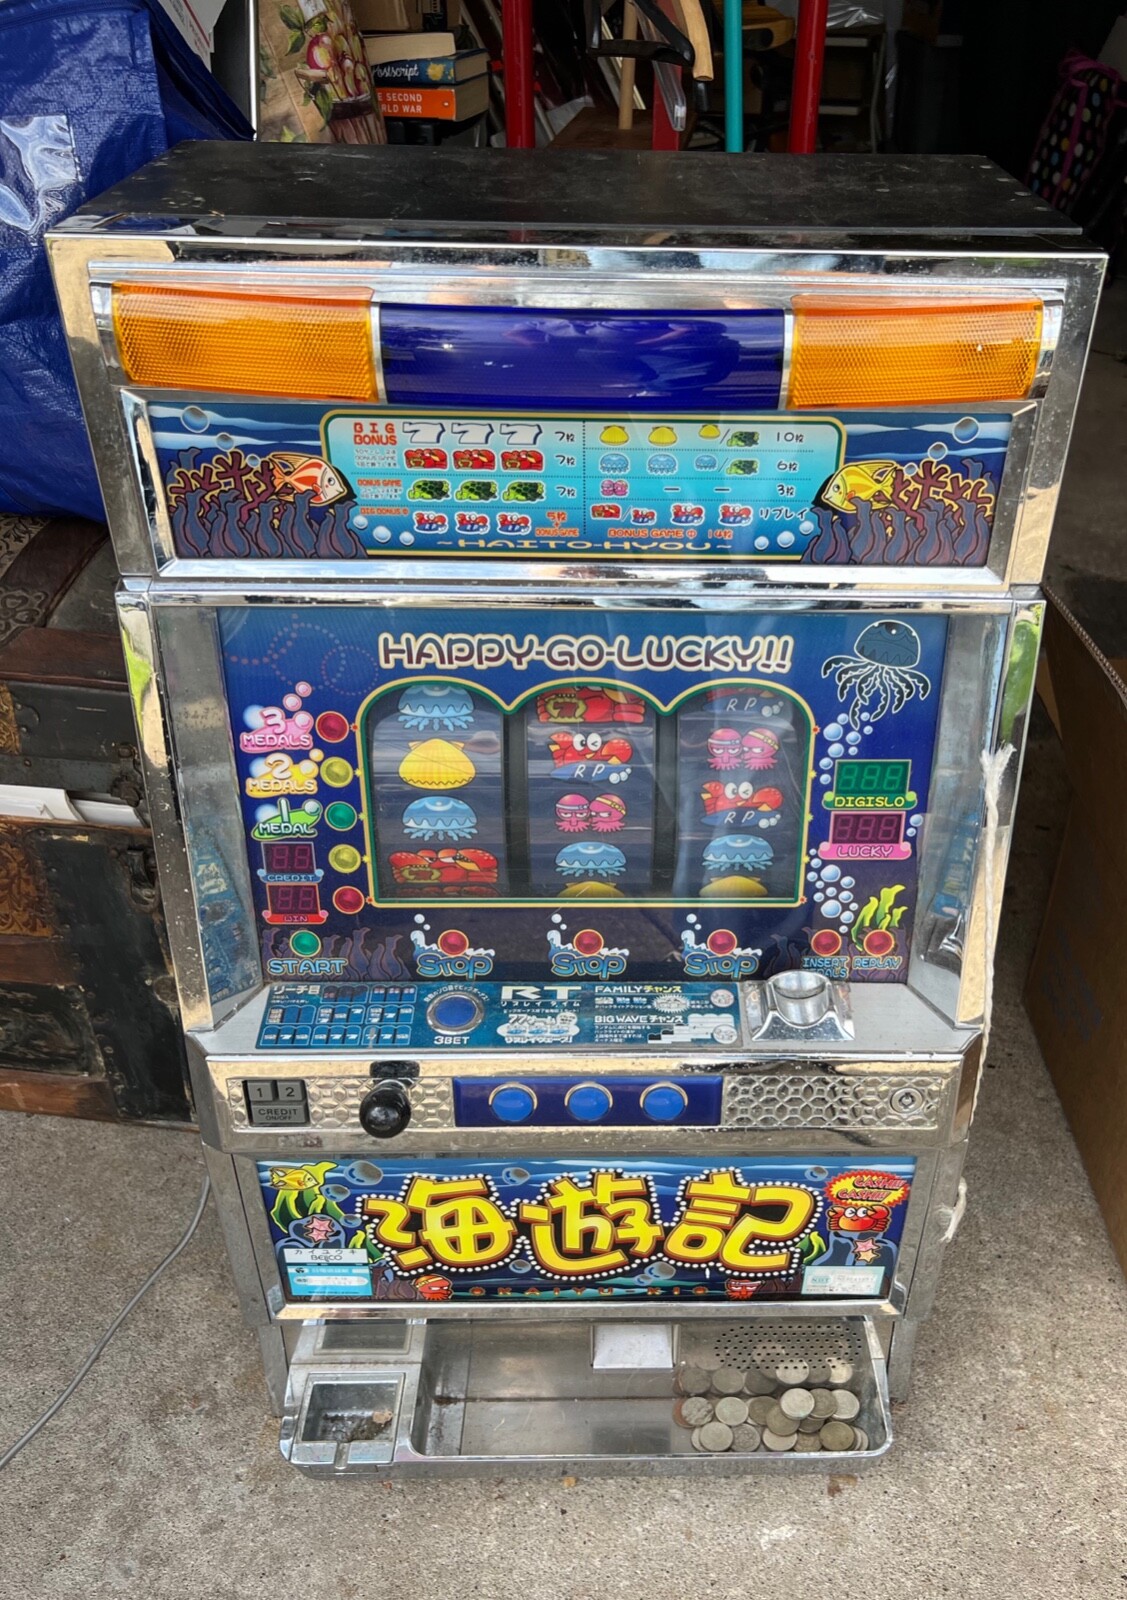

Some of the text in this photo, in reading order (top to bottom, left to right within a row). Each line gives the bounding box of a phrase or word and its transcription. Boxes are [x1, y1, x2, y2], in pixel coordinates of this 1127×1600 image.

[386, 93, 422, 102] SECOND
[380, 104, 422, 113] RLD WAR
[353, 434, 397, 446] BONUS
[608, 528, 648, 538] BONUS
[650, 529, 684, 538] GAME
[261, 708, 284, 734] 3
[242, 733, 310, 747] MEDALS
[267, 753, 293, 778] 2
[249, 778, 315, 792] MEDALS
[834, 796, 905, 807] DIGISLO
[259, 822, 316, 836] MEDAL
[837, 846, 893, 857] LUCKY
[268, 959, 347, 975] START
[803, 957, 847, 968] INSERT
[853, 957, 901, 968] REPLAY
[273, 985, 320, 995] リーチ目
[501, 986, 582, 1000] RT
[434, 1036, 470, 1045] 3BET
[257, 1088, 263, 1098] 1
[286, 1087, 294, 1097] 2
[258, 1108, 298, 1116] CREDIT
